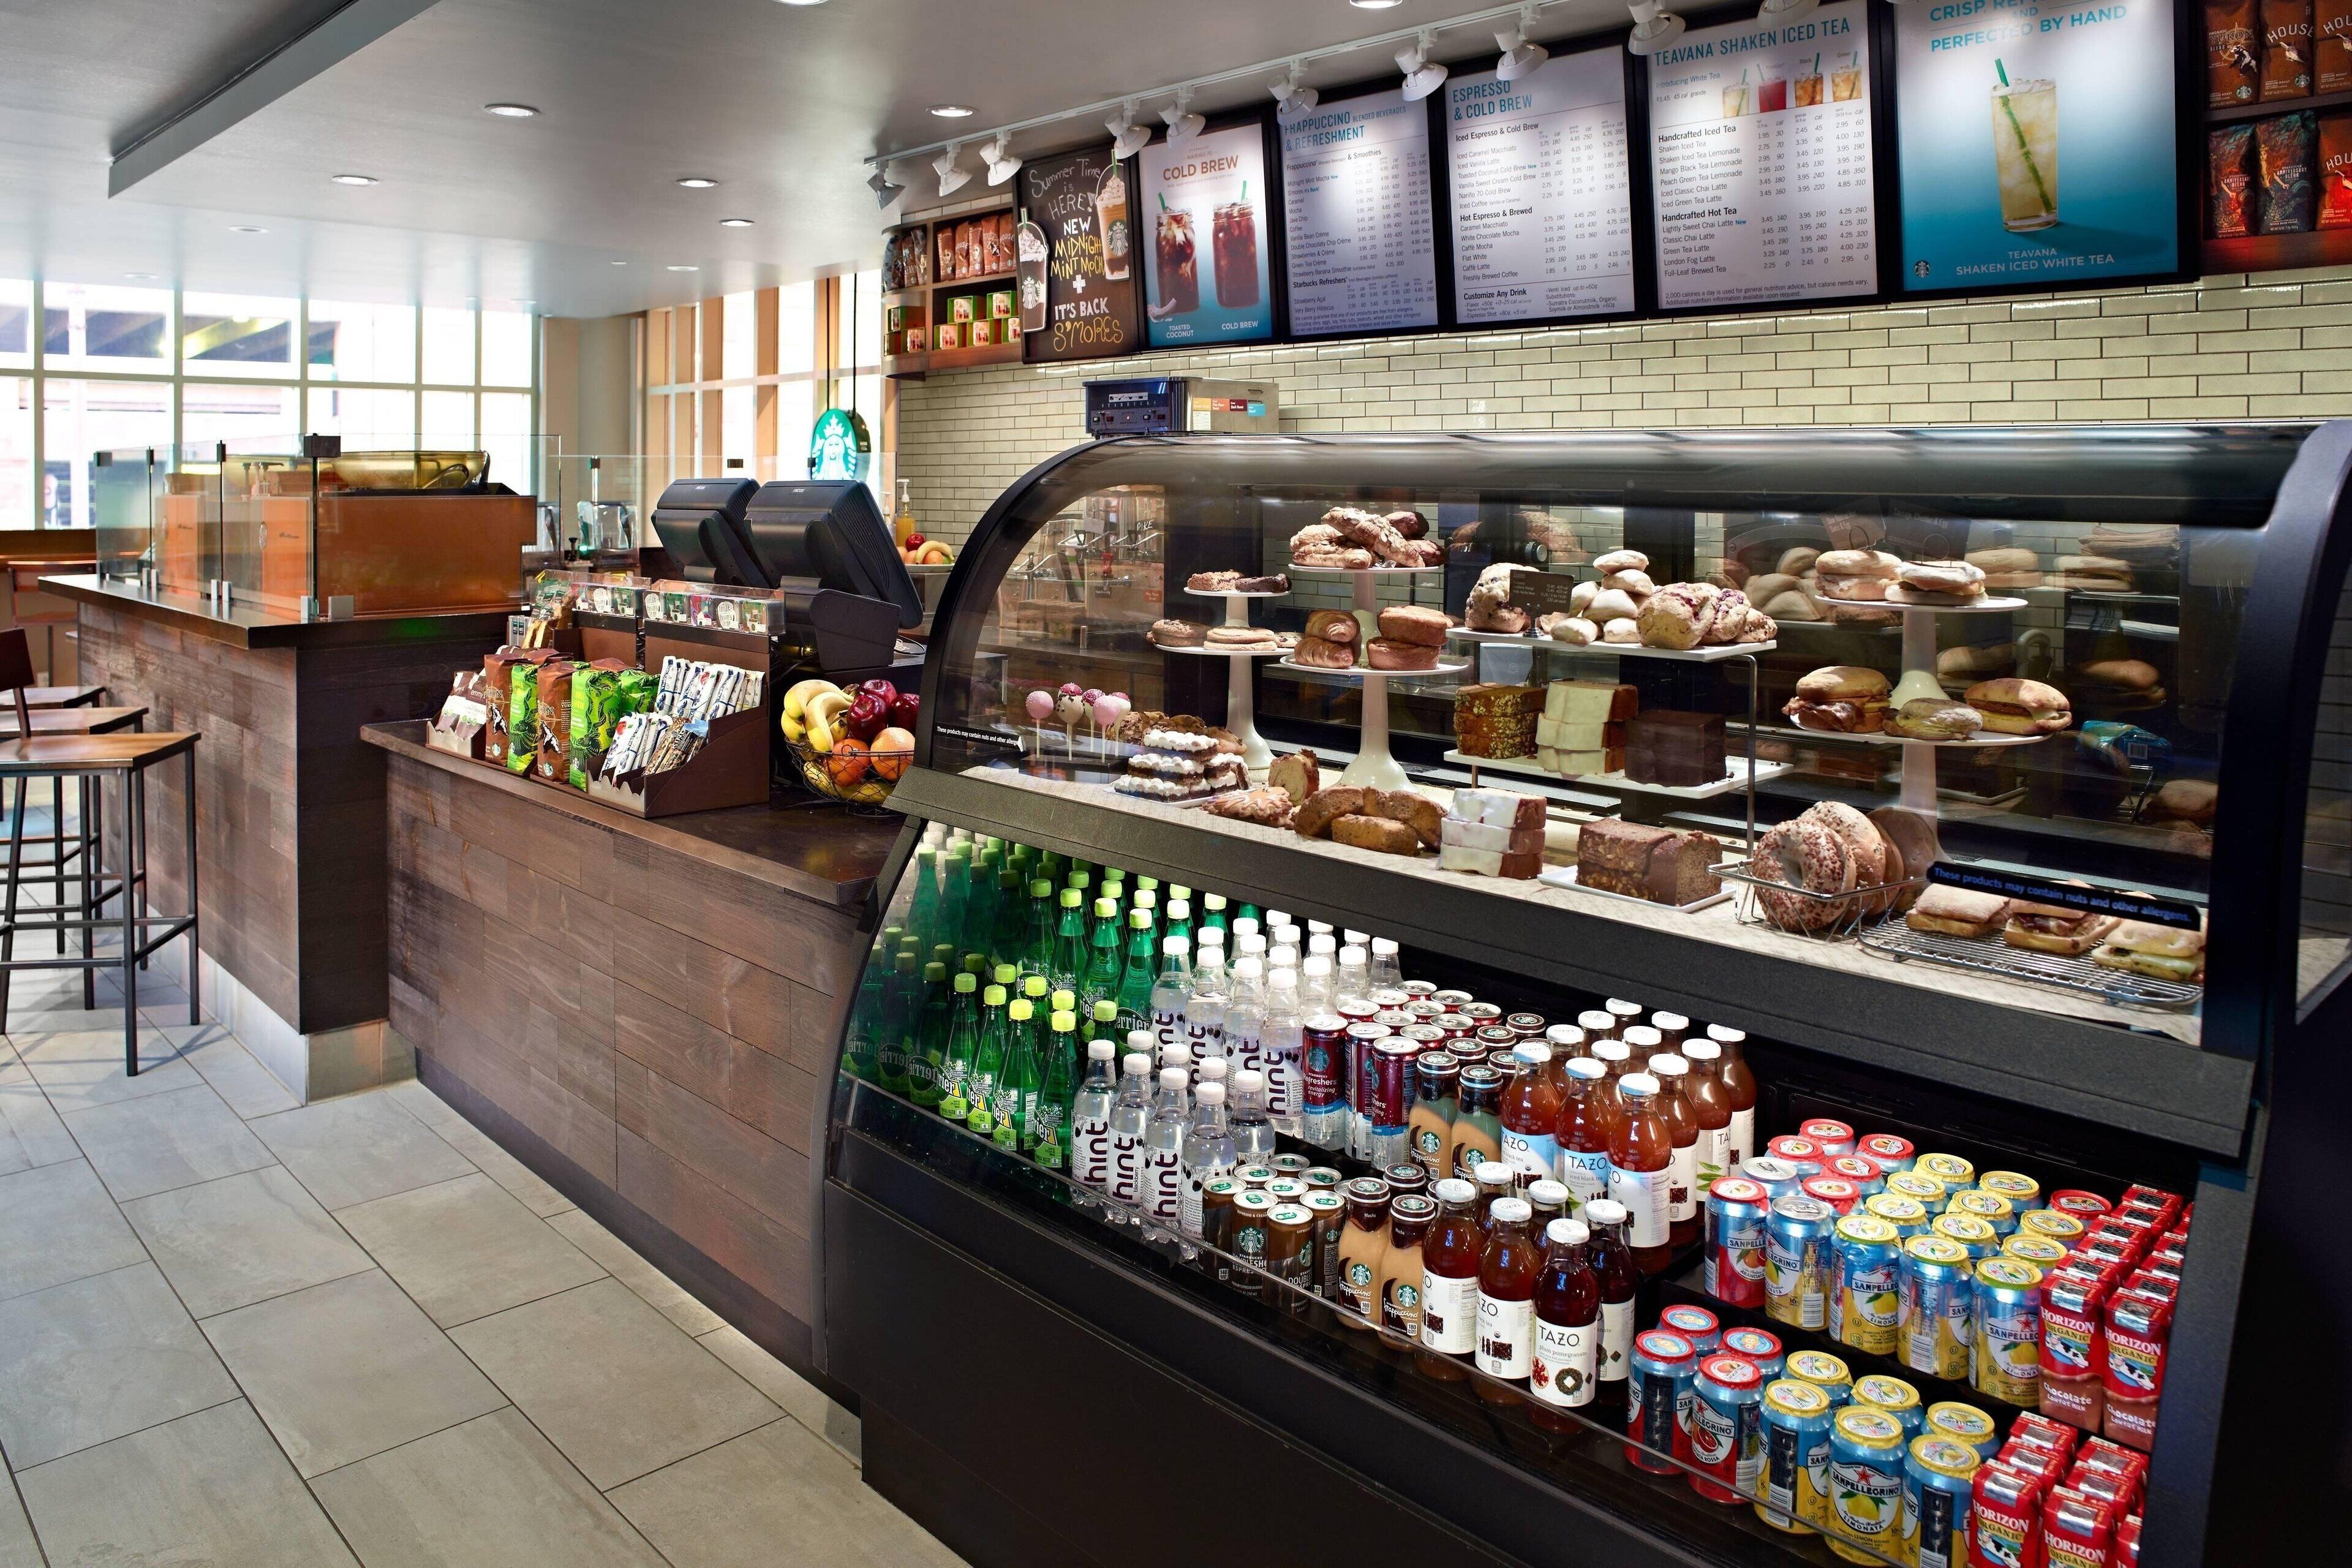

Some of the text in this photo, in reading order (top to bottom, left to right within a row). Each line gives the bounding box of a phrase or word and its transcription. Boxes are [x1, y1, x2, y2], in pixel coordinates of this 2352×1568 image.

[2013, 7, 2038, 18] AND
[1932, 6, 2127, 52] PERFECTED BY HAND
[2267, 23, 2313, 43] HOUSE
[1654, 17, 1850, 66] TEAVANA SHAKEN ICED TEA
[1453, 80, 1510, 102] ESPRESSO
[1352, 112, 1374, 122] BLENDED
[1376, 105, 1406, 118] BEVERAGES
[1454, 94, 1532, 119] & COLD BREW
[1286, 126, 1364, 151] & REFRESHMENT
[1456, 133, 1469, 141] Iced
[1470, 129, 1498, 140] Espresso
[1658, 129, 1702, 142] Handcrafted
[1704, 127, 1720, 135] Iced
[1030, 159, 1100, 198] Summer Time
[1163, 164, 1196, 181] COLD
[1201, 155, 1238, 174] BREW
[1064, 182, 1073, 192] is
[1049, 192, 1095, 220] HERE!
[1472, 211, 1500, 221] Espresso
[1509, 206, 1532, 215] Brewed
[1662, 210, 1705, 222] Handcrafted
[1063, 216, 1091, 235] NEW
[1956, 253, 2114, 276] SHAKEN ICED WHITE TEA
[2008, 247, 2057, 259] TEAVANA
[1293, 276, 1346, 288] Starbucks Refreshers
[1463, 291, 1495, 300] Customize
[1497, 290, 1508, 299] Any
[1055, 297, 1109, 320] IT'S BACK
[1934, 867, 1960, 882] These
[1962, 874, 2002, 889] products
[2005, 882, 2024, 894] may
[2027, 886, 2064, 899] contain
[2065, 894, 2087, 905] nuts
[2090, 897, 2109, 908] and
[2111, 901, 2138, 913] other
[1266, 1048, 1286, 1115] hint
[1308, 1086, 1335, 1095] revitalizing
[1084, 1119, 1109, 1183] hint
[1112, 1134, 1134, 1200] hint
[1153, 1151, 1178, 1218] hint
[2041, 1306, 2095, 1334] HORIZON
[2046, 1323, 2089, 1341] ORGANIC
[2105, 1326, 2161, 1355] HORIZON
[1539, 1345, 1587, 1358] plum pomegranate
[2110, 1342, 2155, 1364] ORGANIC
[1832, 1471, 1899, 1496] SANPELLEGRINO
[1844, 1515, 1883, 1531] LIMONATA
[1973, 1499, 2029, 1532] HORIZON
[1854, 1534, 1873, 1543] LEMON
[1978, 1518, 2022, 1542] ORGANIC
[2044, 1530, 2106, 1562] HORIZON
